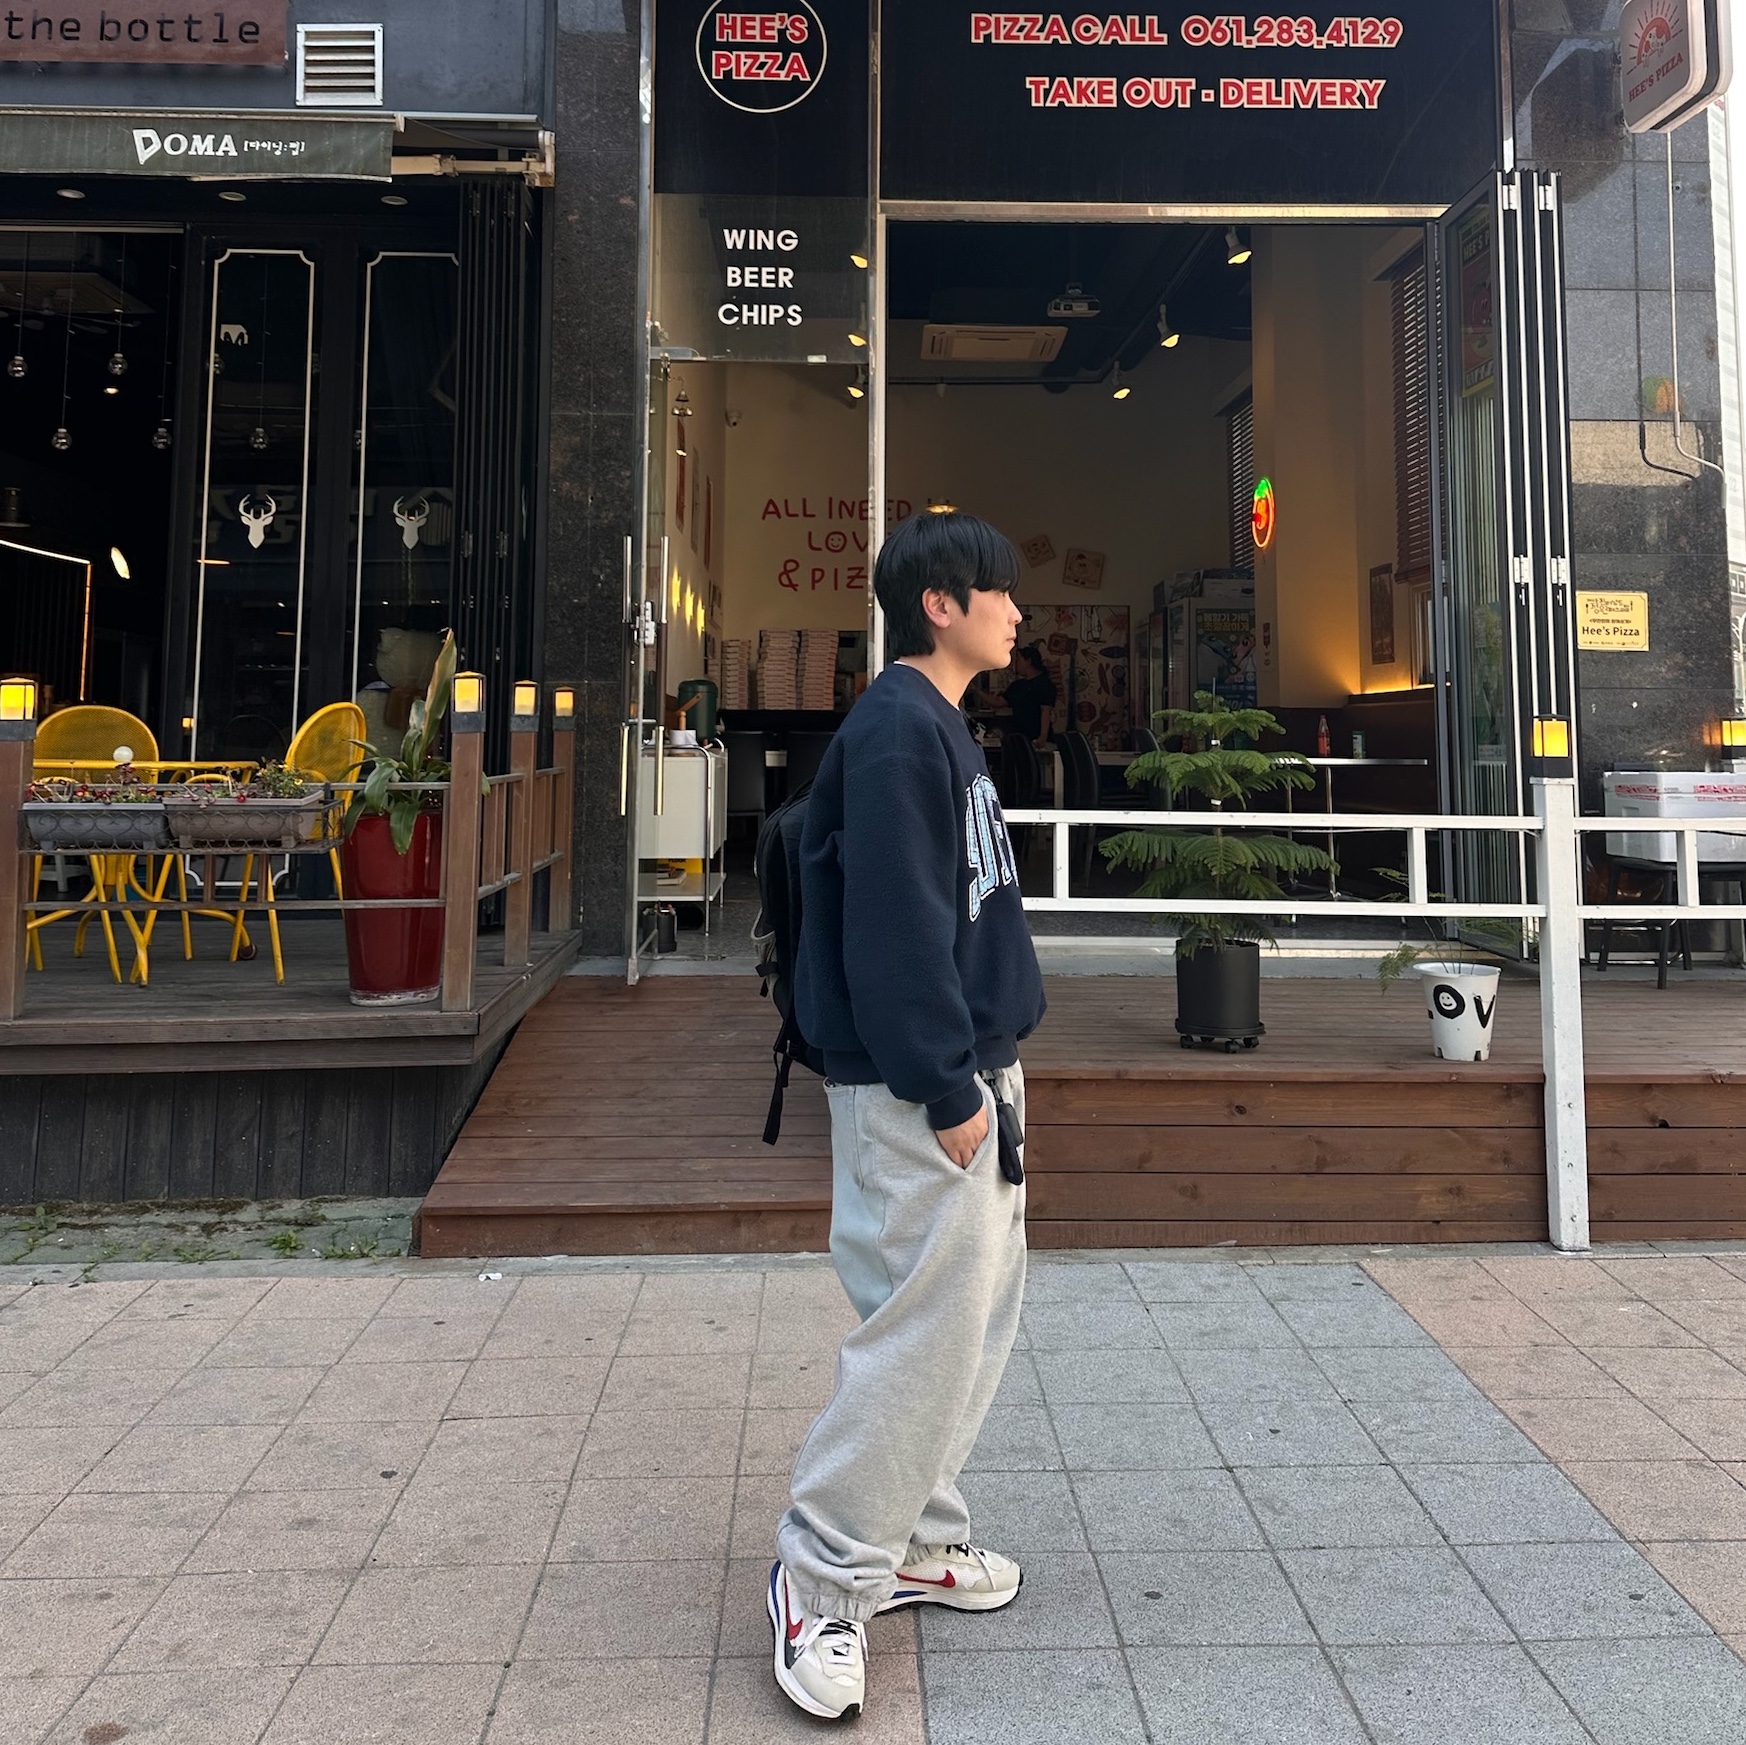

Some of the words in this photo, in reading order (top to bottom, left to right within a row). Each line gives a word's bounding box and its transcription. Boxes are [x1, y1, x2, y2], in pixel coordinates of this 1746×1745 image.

[5, 10, 82, 41] the
[99, 10, 260, 44] bottle
[716, 12, 809, 44] HEE'S
[970, 13, 1071, 44] PIZZA
[1072, 14, 1168, 45] CALL
[1181, 16, 1404, 49] 061.283.4129
[712, 50, 812, 81] PIZZA
[1628, 74, 1655, 102] HEE'S
[1655, 52, 1684, 82] PIZZA
[1026, 77, 1117, 108] TAKE
[1122, 77, 1196, 109] OUT
[1220, 78, 1387, 110] DELIVERY
[132, 128, 238, 165] DOMA
[723, 229, 799, 251] WING
[726, 266, 794, 288] BEER
[718, 303, 803, 326] CHIPS
[761, 497, 816, 520] ALL
[1582, 626, 1610, 636] Hee's
[1613, 626, 1640, 636] Pizza
